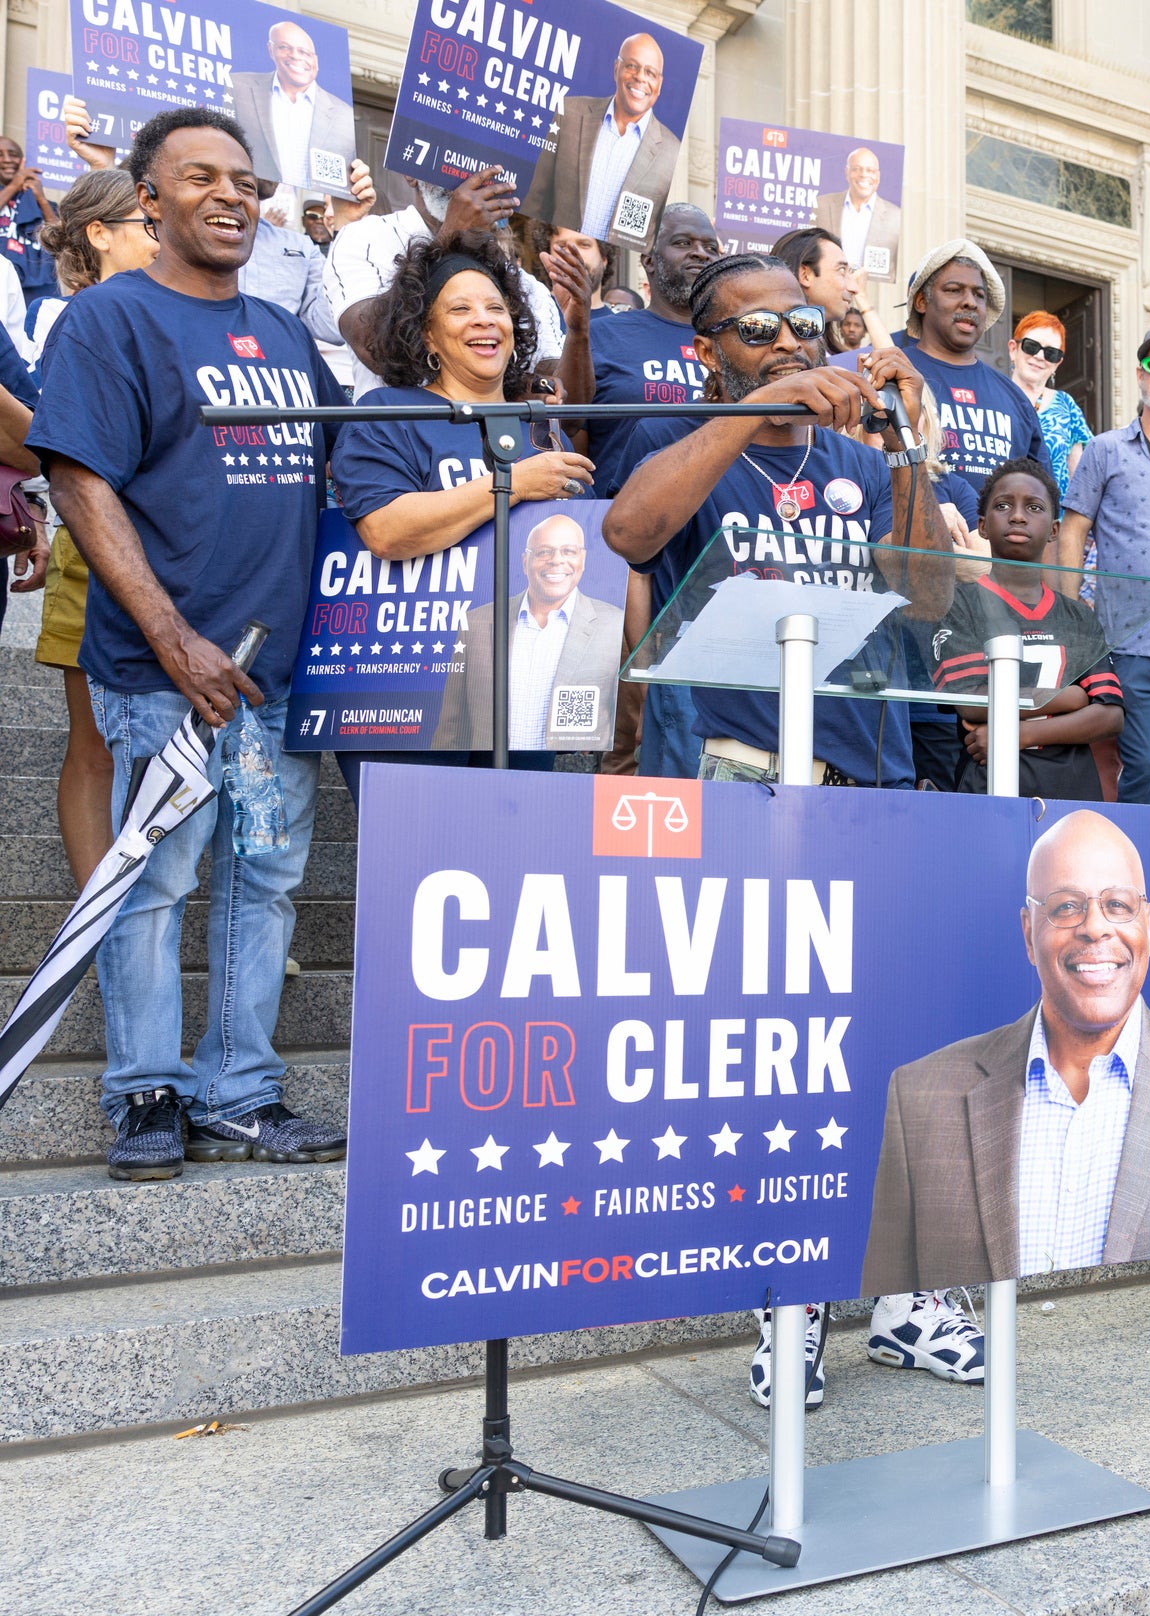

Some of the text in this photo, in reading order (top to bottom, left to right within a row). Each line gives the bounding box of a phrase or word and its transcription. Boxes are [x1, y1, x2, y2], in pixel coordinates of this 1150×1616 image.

[82, 0, 232, 60] CALVIN
[430, 0, 582, 80] CALVIN
[83, 27, 234, 89] FOR CLERK
[420, 30, 570, 116] FOR CLERK
[86, 76, 127, 93] FAIRNESS
[136, 87, 197, 108] TRANSPARENCY
[37, 120, 65, 144] FO
[91, 113, 115, 136] #7
[412, 91, 558, 153] FAIRNESS TRANSPARENCY JUSTICE
[402, 138, 431, 167] #7
[441, 164, 460, 177] CLERK
[443, 149, 478, 173] CALVIN
[725, 145, 821, 187] CALVIN
[724, 176, 819, 209] FOR CLERK
[196, 364, 316, 408] CALVIN
[644, 382, 687, 404] FOR
[266, 421, 315, 448] CLER
[940, 403, 1012, 441] ALVIN
[722, 511, 871, 568] CALVIN
[319, 546, 479, 597] CALVIN
[311, 600, 472, 636] FOR CLERK
[306, 662, 465, 676] FAIRNESS TRANSPARENCY JUSTICE
[299, 709, 423, 736] #7 CALVIN DUNCAN
[339, 725, 421, 735] CLERK OF CRIMINAL COURT
[410, 869, 854, 1001] CALVIN
[405, 1016, 853, 1114] FOR CLERK
[401, 1172, 849, 1233] DILIGENCE FAIRNESS JUSTICE
[421, 1237, 829, 1300] CALVINFORCLERK.COM
